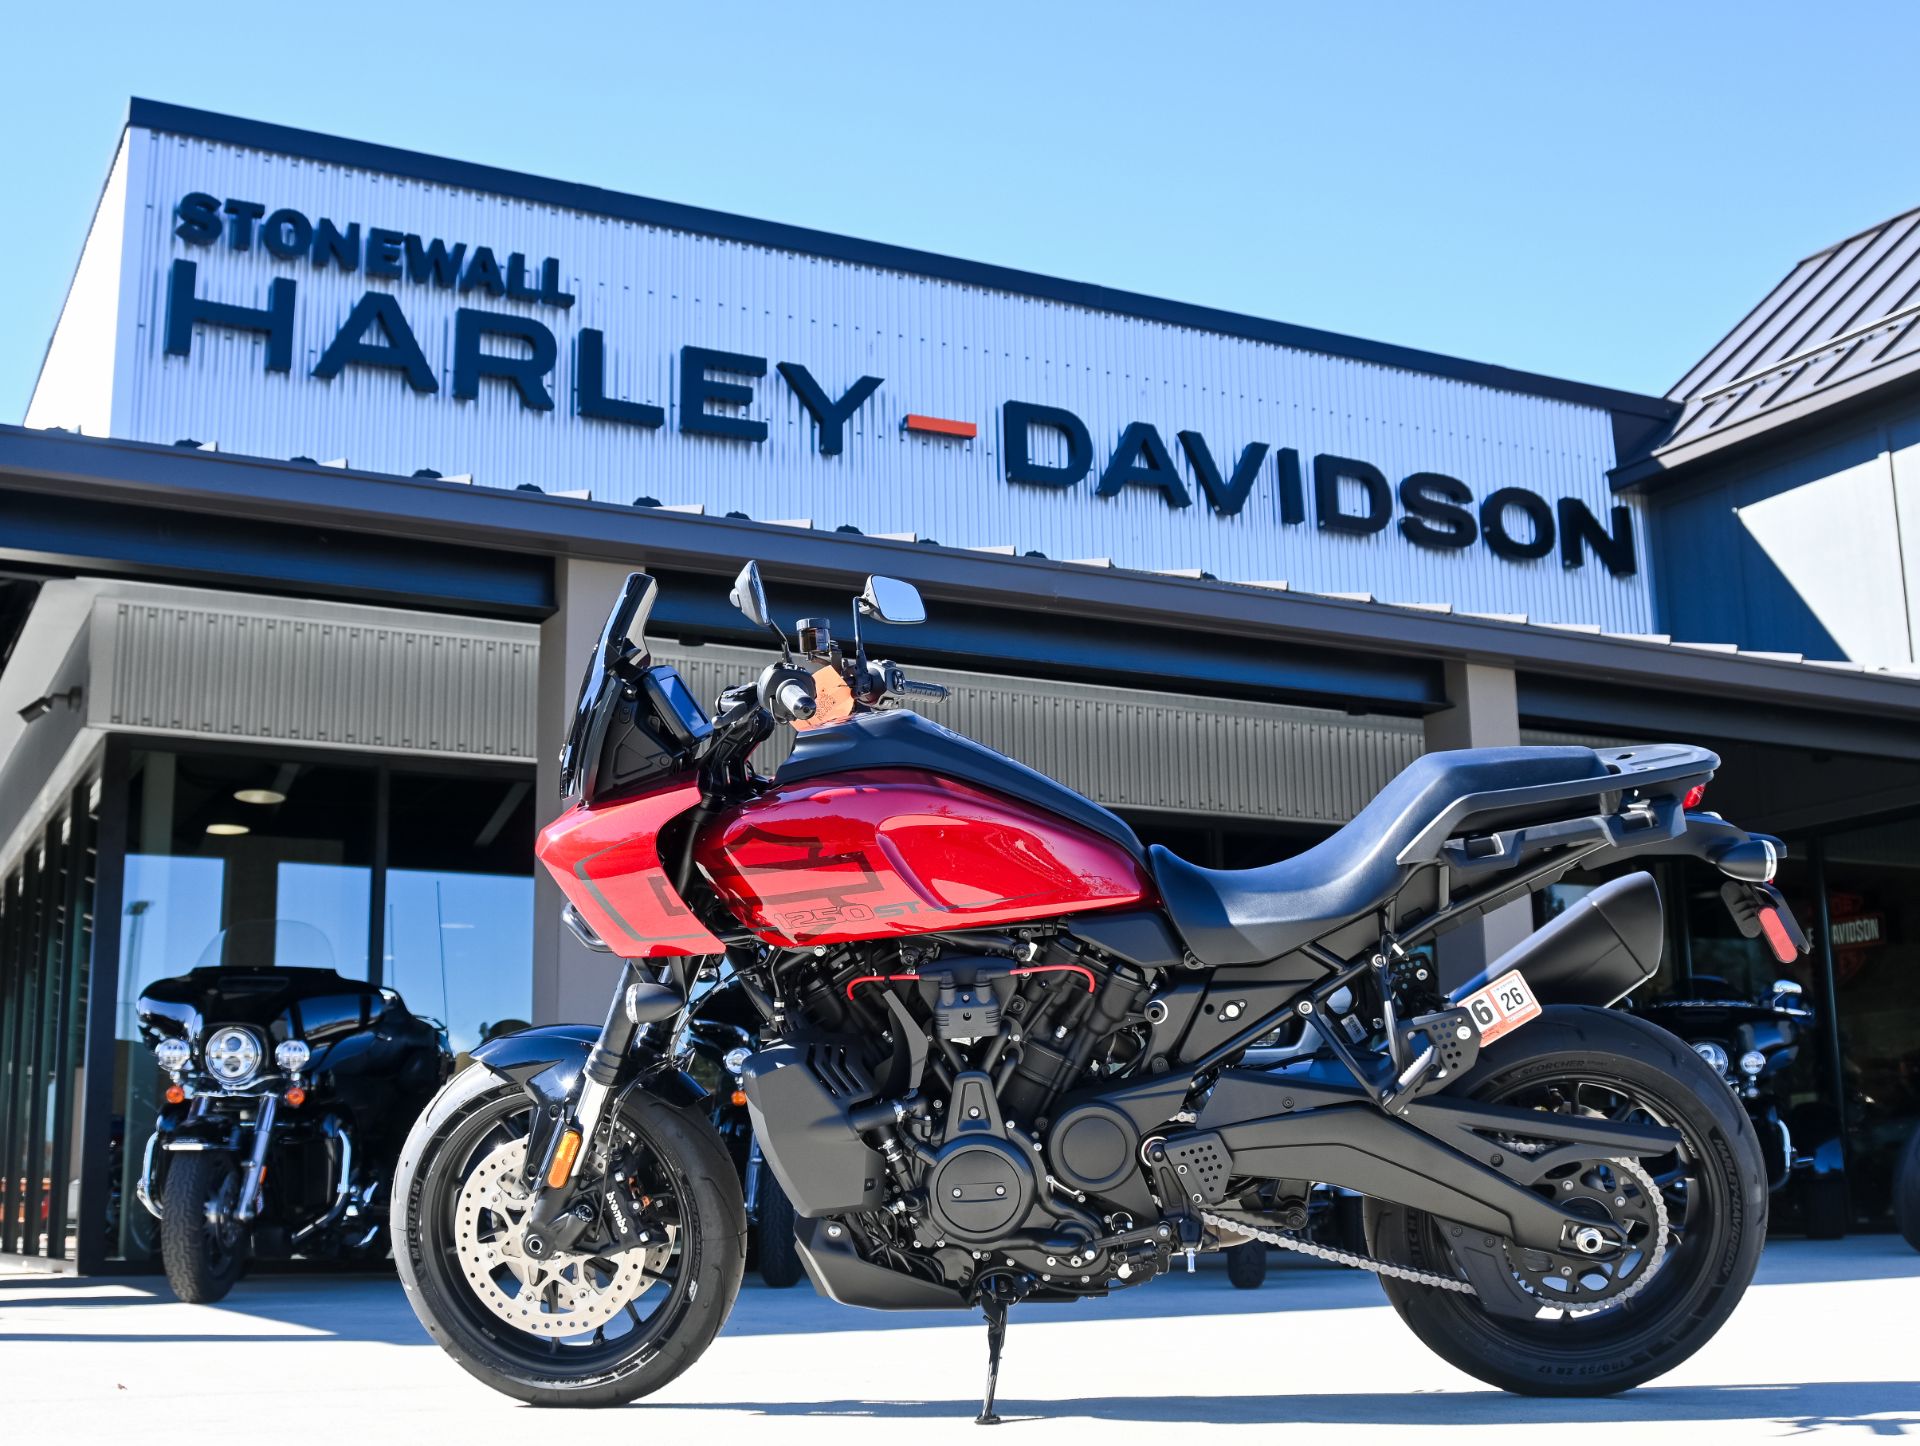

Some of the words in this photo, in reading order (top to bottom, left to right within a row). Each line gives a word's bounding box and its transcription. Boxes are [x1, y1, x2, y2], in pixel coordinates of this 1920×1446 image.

[174, 191, 575, 308] STONEWALL
[1471, 998, 1494, 1026] 6
[1500, 986, 1524, 1012] 26
[407, 1182, 421, 1260] MICHELIN
[605, 1190, 628, 1235] brembo
